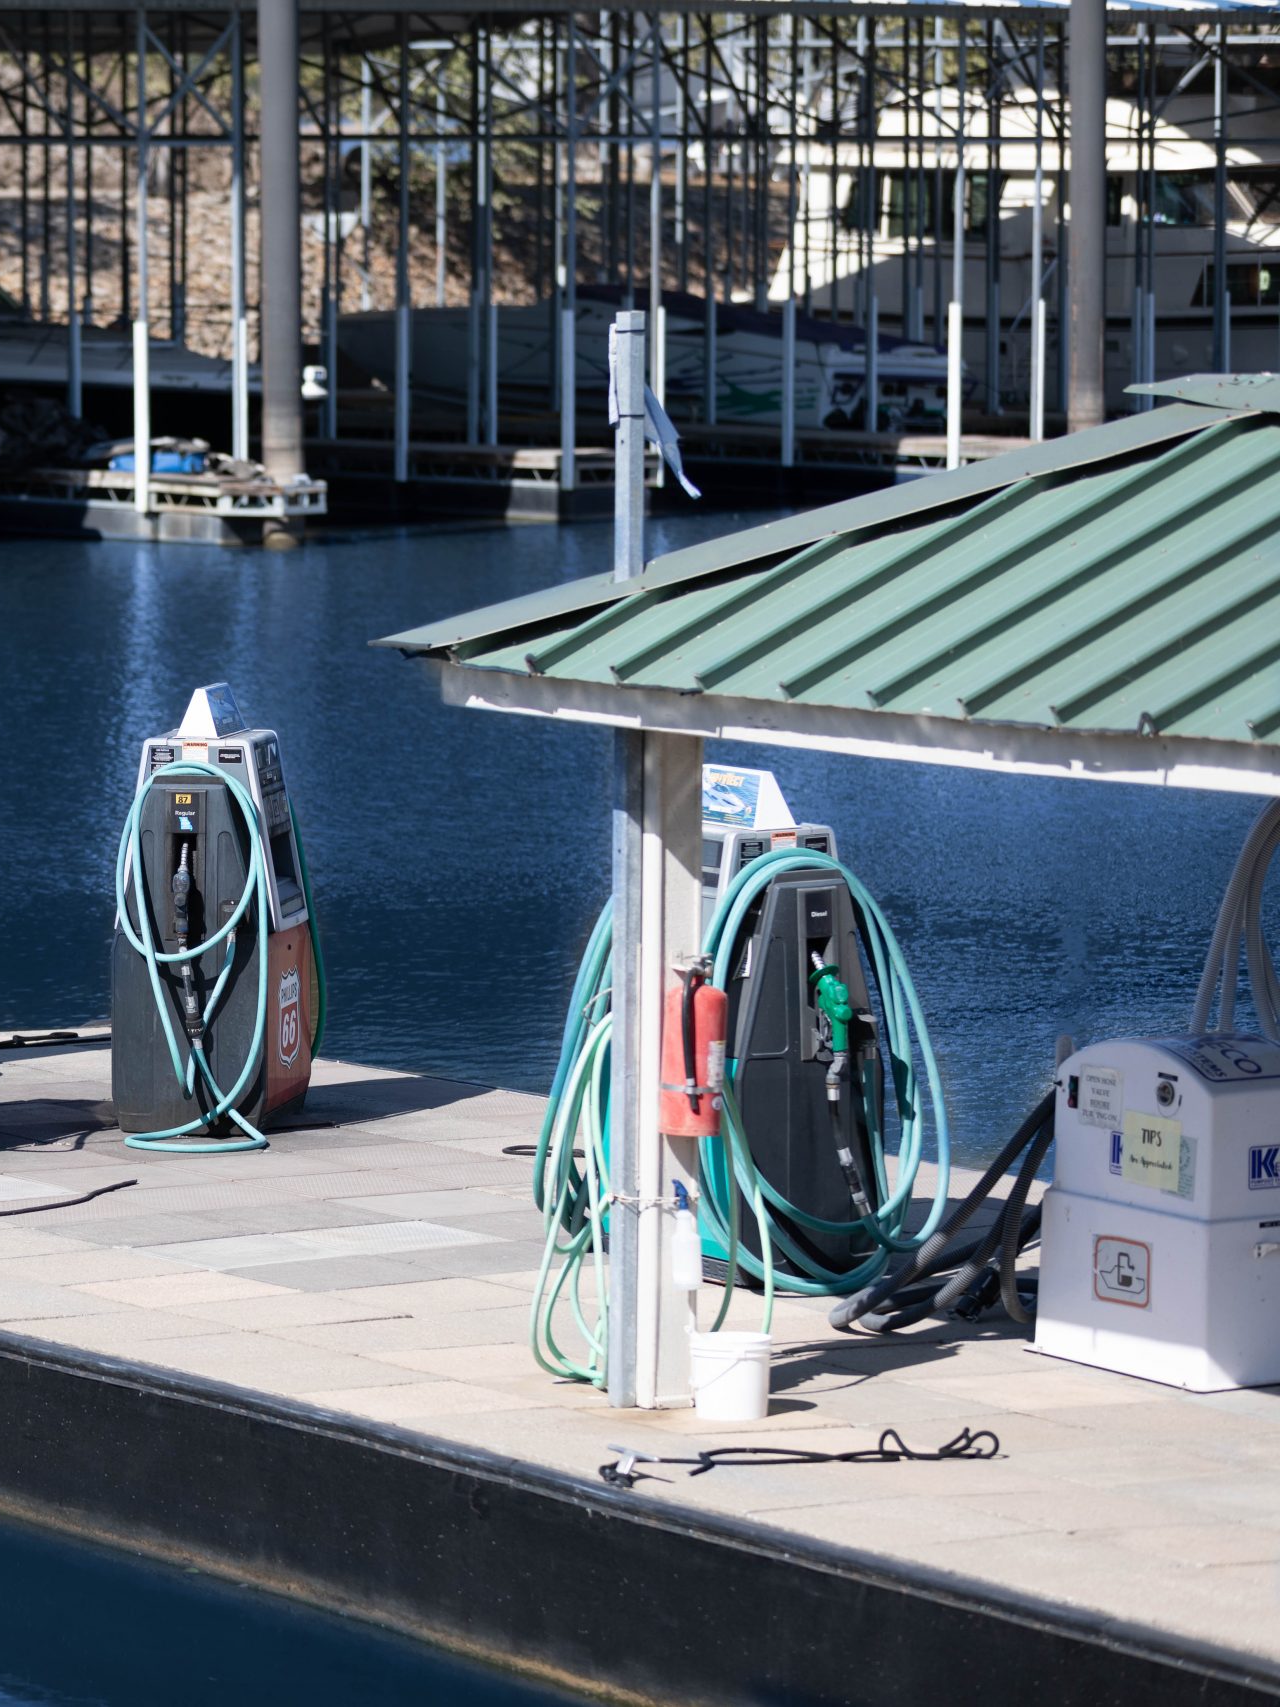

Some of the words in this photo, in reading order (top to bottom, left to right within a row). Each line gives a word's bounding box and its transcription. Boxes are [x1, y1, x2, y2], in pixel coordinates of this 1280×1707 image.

[177, 796, 188, 804] 87
[281, 982, 297, 1003] PHILLIPS
[282, 1009, 296, 1048] 66
[1141, 1128, 1162, 1147] TIPS
